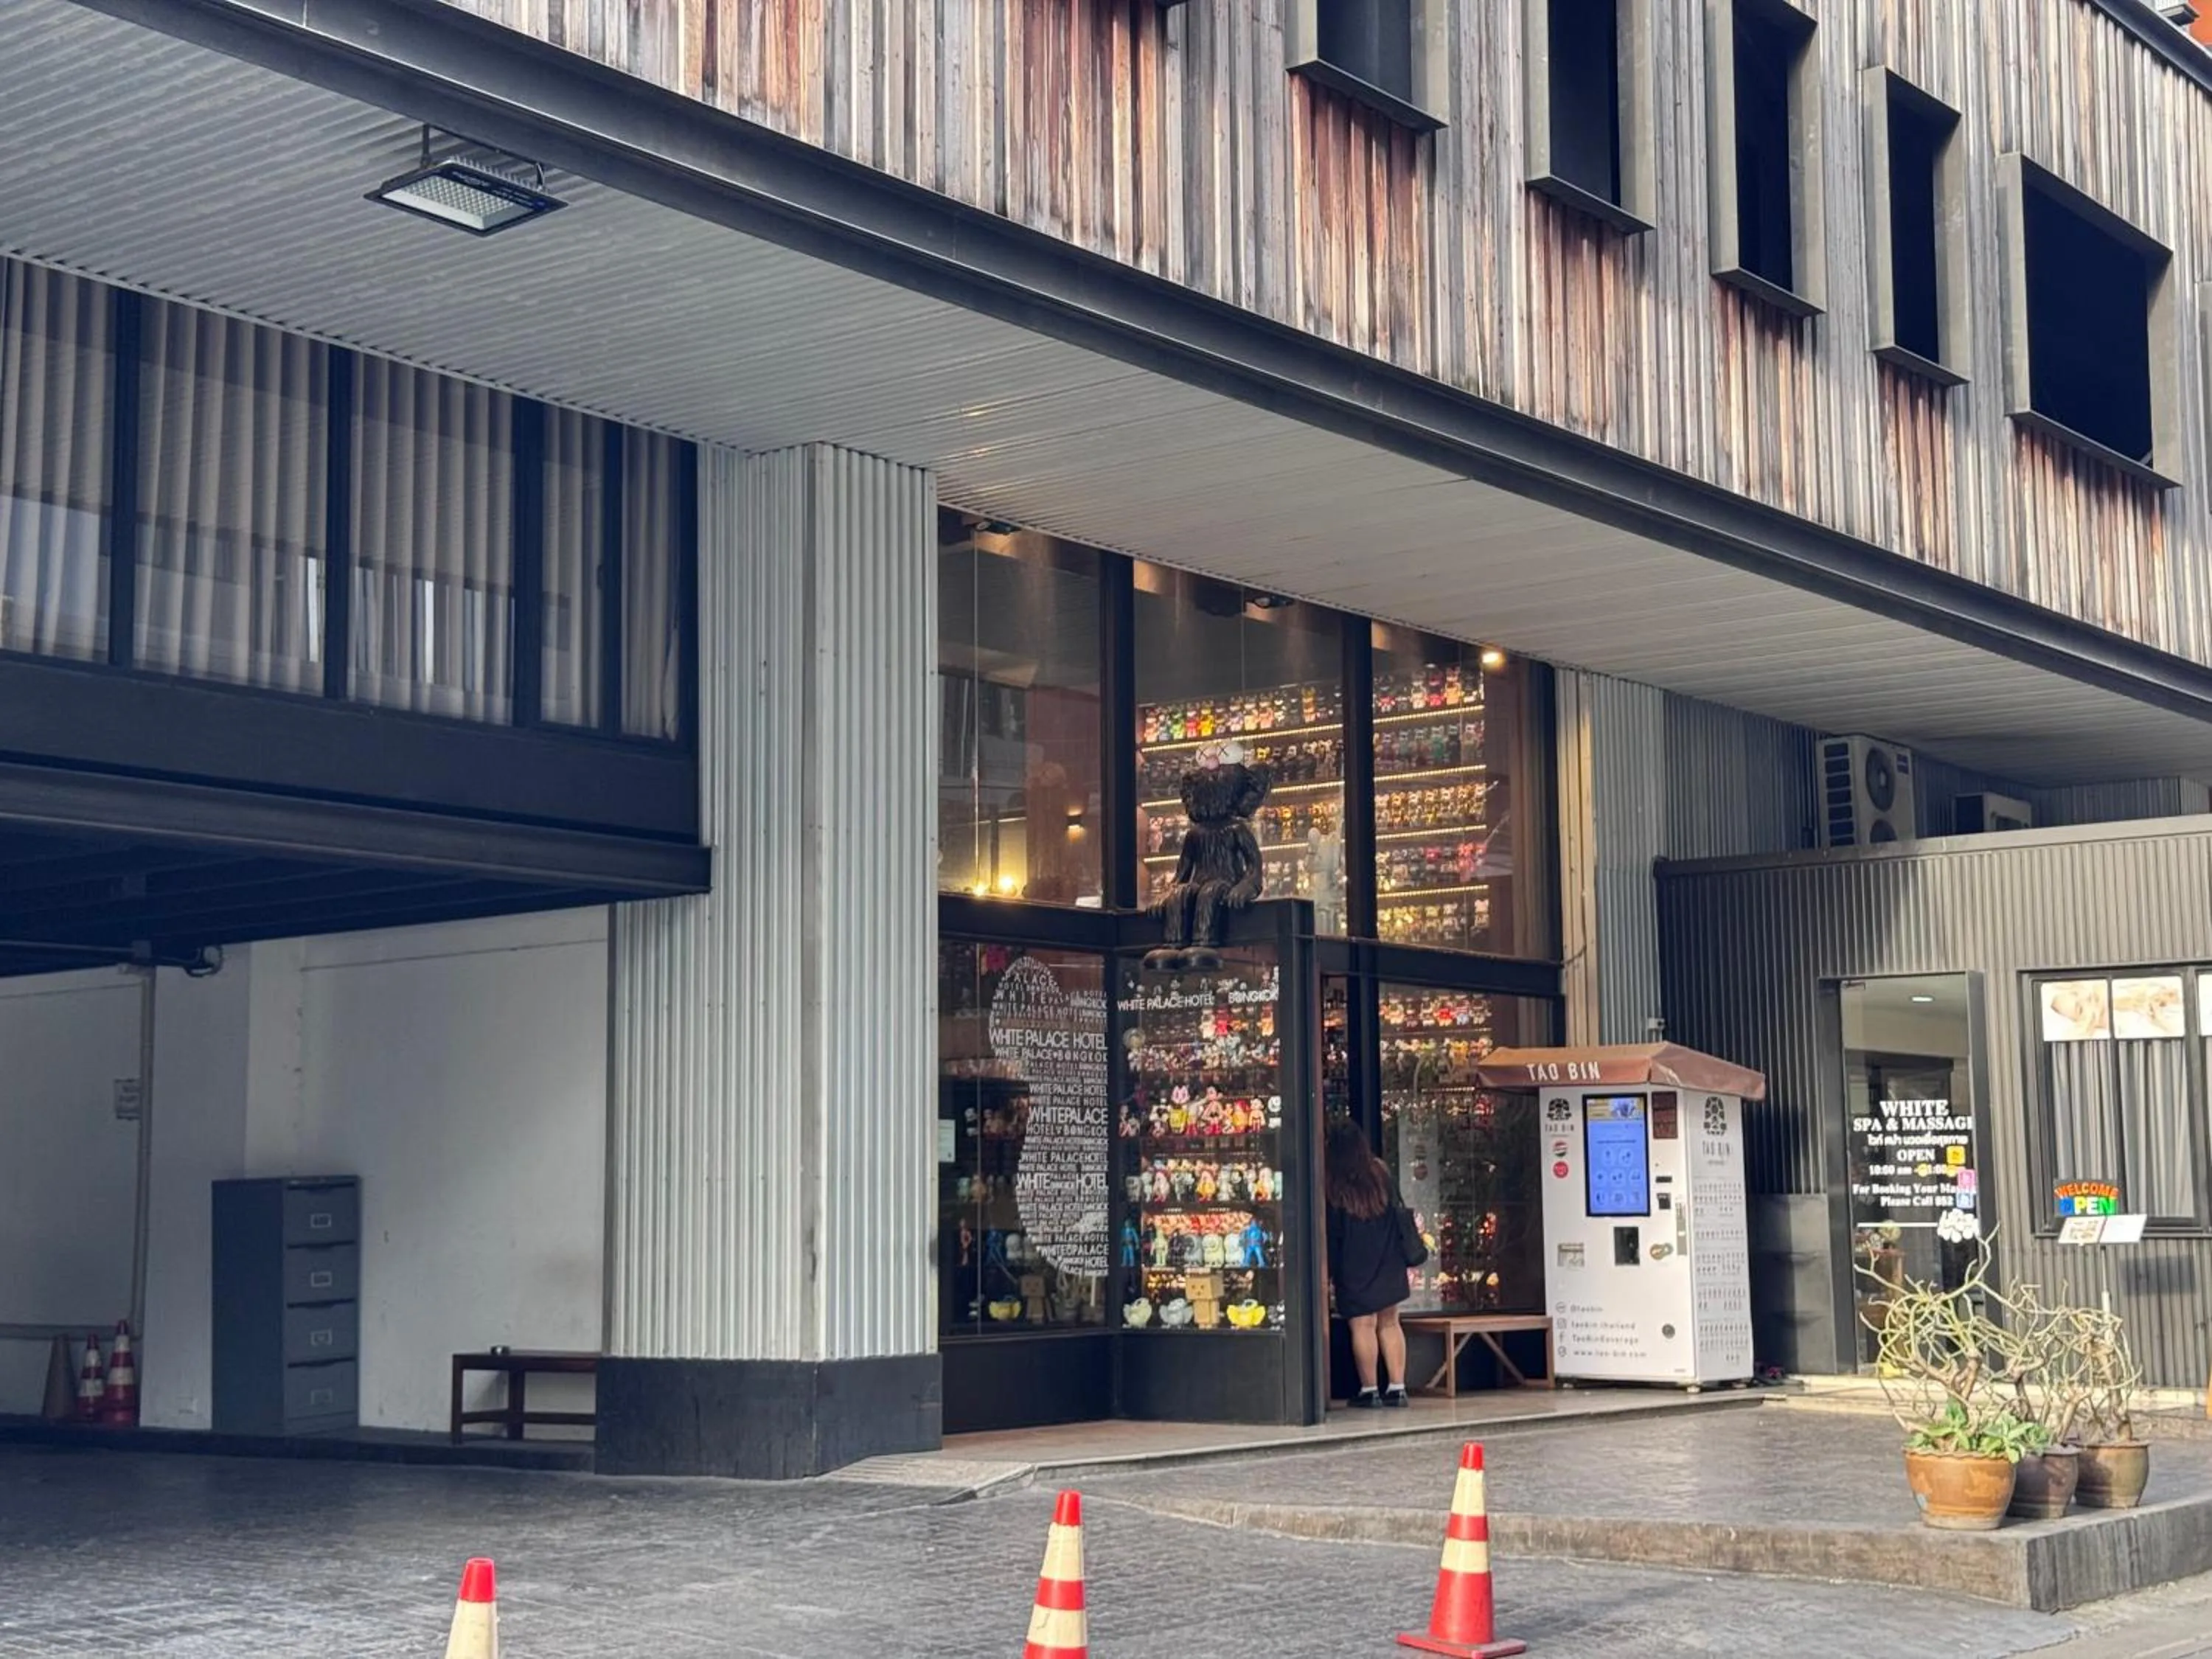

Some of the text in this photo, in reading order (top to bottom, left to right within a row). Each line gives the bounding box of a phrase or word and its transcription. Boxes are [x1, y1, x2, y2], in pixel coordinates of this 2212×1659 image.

[1117, 999, 1144, 1011] WHITE
[1147, 995, 1183, 1009] PALACE
[1184, 992, 1214, 1006] HOTEL
[989, 1028, 1107, 1050] WHITE PALACE HOTEL
[995, 1046, 1020, 1057] WHITE
[1021, 1047, 1052, 1060] PALACE
[1526, 1062, 1601, 1082] TAO BIN
[1084, 1085, 1107, 1096] HOTEL
[1879, 1099, 1950, 1117] WHITE
[1026, 1123, 1054, 1135] HOTEL
[1545, 1124, 1558, 1133] TAO
[1853, 1117, 1882, 1132] SPA
[1886, 1117, 1899, 1131] &
[1896, 1148, 1935, 1161] OPEN
[1016, 1172, 1050, 1190] WHITE
[1076, 1172, 1108, 1190] HOTEL
[1852, 1183, 1870, 1194] For
[1872, 1183, 1911, 1196] Booking
[1913, 1183, 1938, 1194] Your
[2053, 1182, 2119, 1199] WELCOME
[1880, 1194, 1911, 1207] Please
[1913, 1194, 1933, 1206] Call
[2059, 1195, 2117, 1216] OPEN
